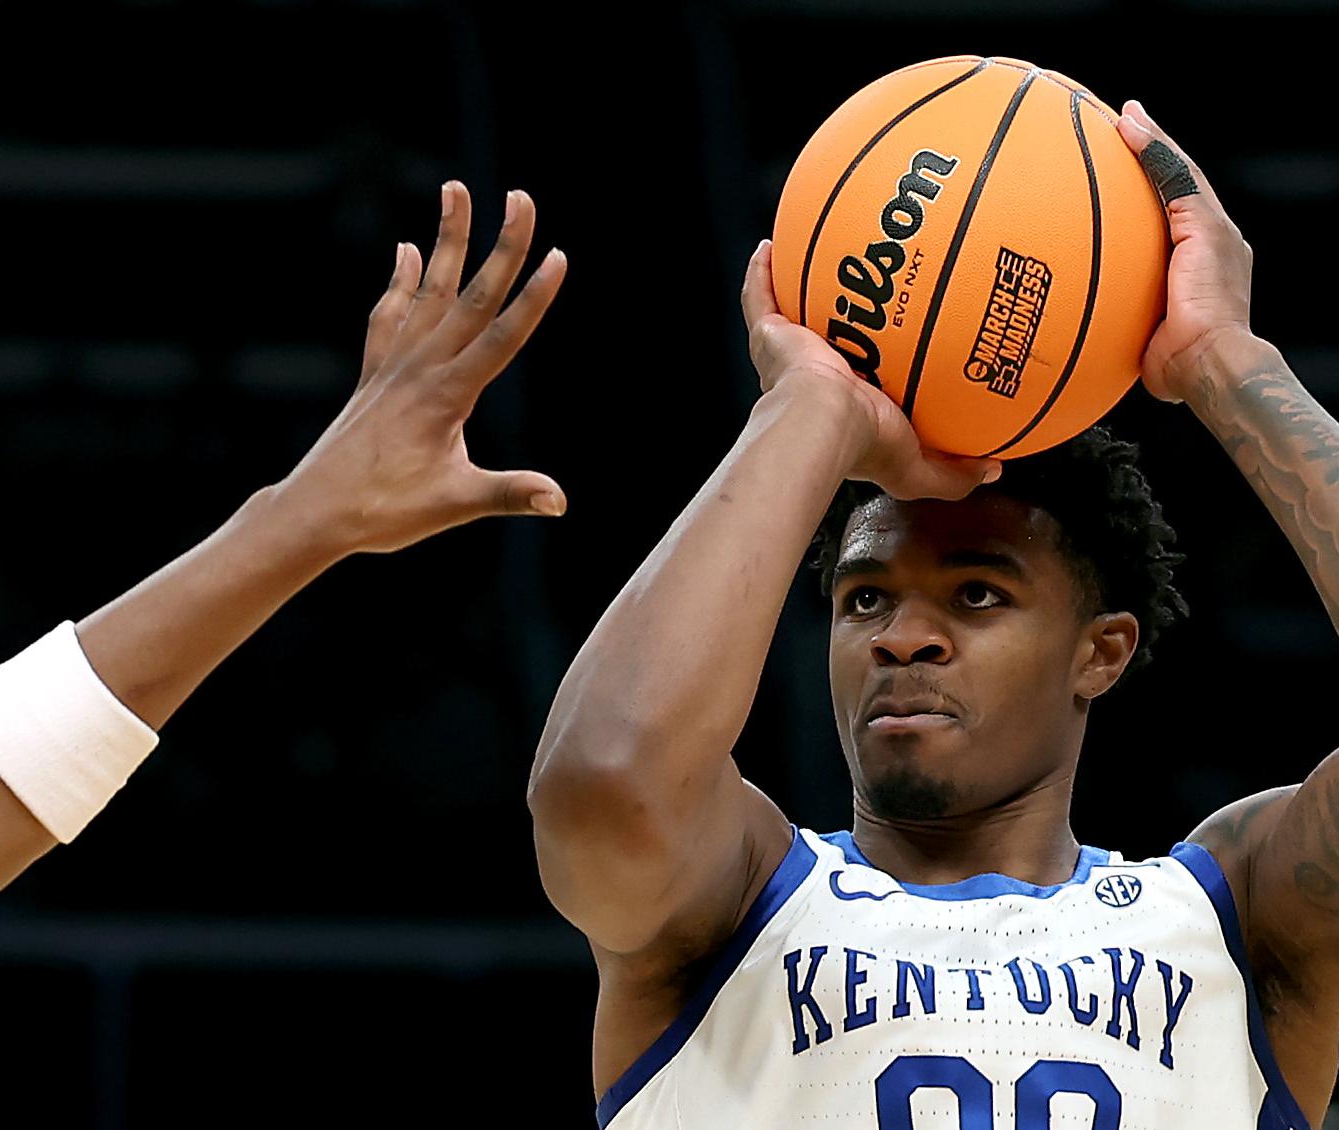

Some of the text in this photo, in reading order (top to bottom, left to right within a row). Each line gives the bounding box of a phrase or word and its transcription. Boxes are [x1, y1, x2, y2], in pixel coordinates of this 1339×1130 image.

[892, 248, 925, 328] EVO NXT
[974, 288, 1015, 364] MARCH
[999, 259, 1045, 361] MADNESS
[1095, 875, 1142, 907] SEC
[783, 946, 1193, 1070] KENTUCKY
